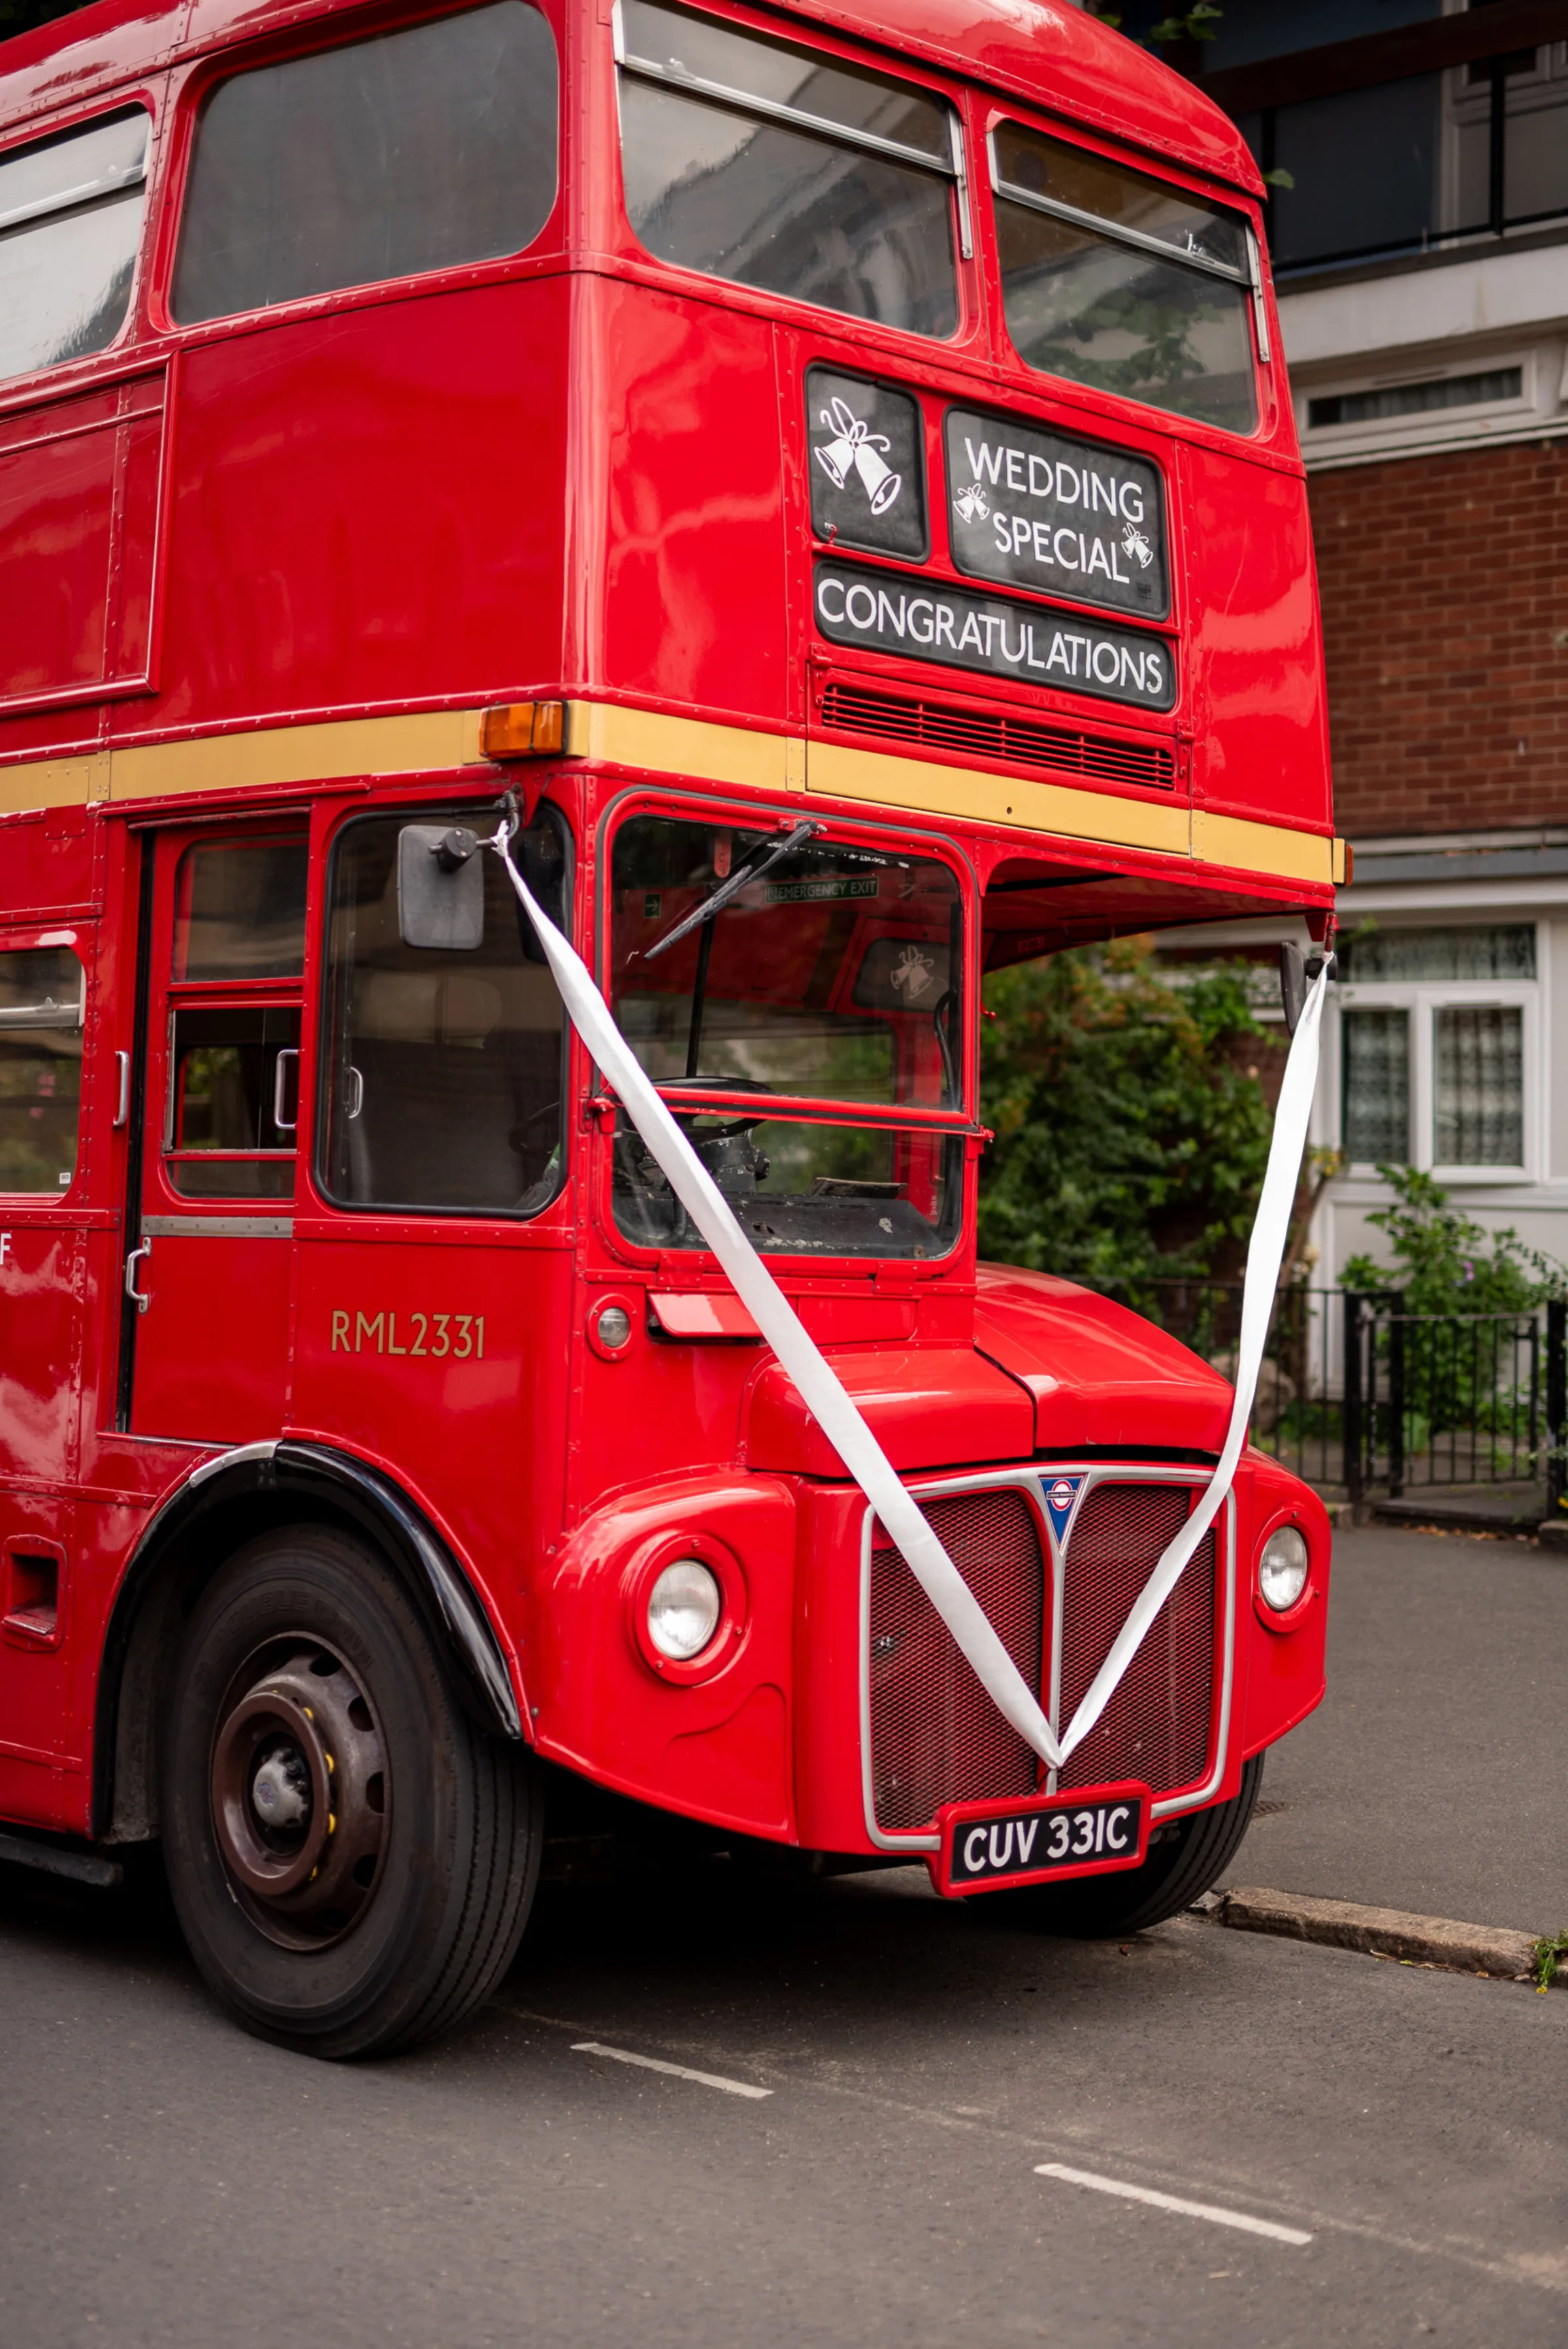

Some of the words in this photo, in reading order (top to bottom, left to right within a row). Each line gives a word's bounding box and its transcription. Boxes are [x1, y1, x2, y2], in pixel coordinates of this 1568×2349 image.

[964, 437, 1144, 522] WEDDING
[993, 512, 1130, 583] SPECIAL
[817, 578, 1162, 694] CONGRATULATIONS
[778, 883, 846, 899] EMERGENCY
[851, 881, 875, 894] EXIT
[331, 1309, 484, 1358] RML2331
[964, 1819, 1039, 1872] CUV
[1047, 1807, 1130, 1858] 331C
